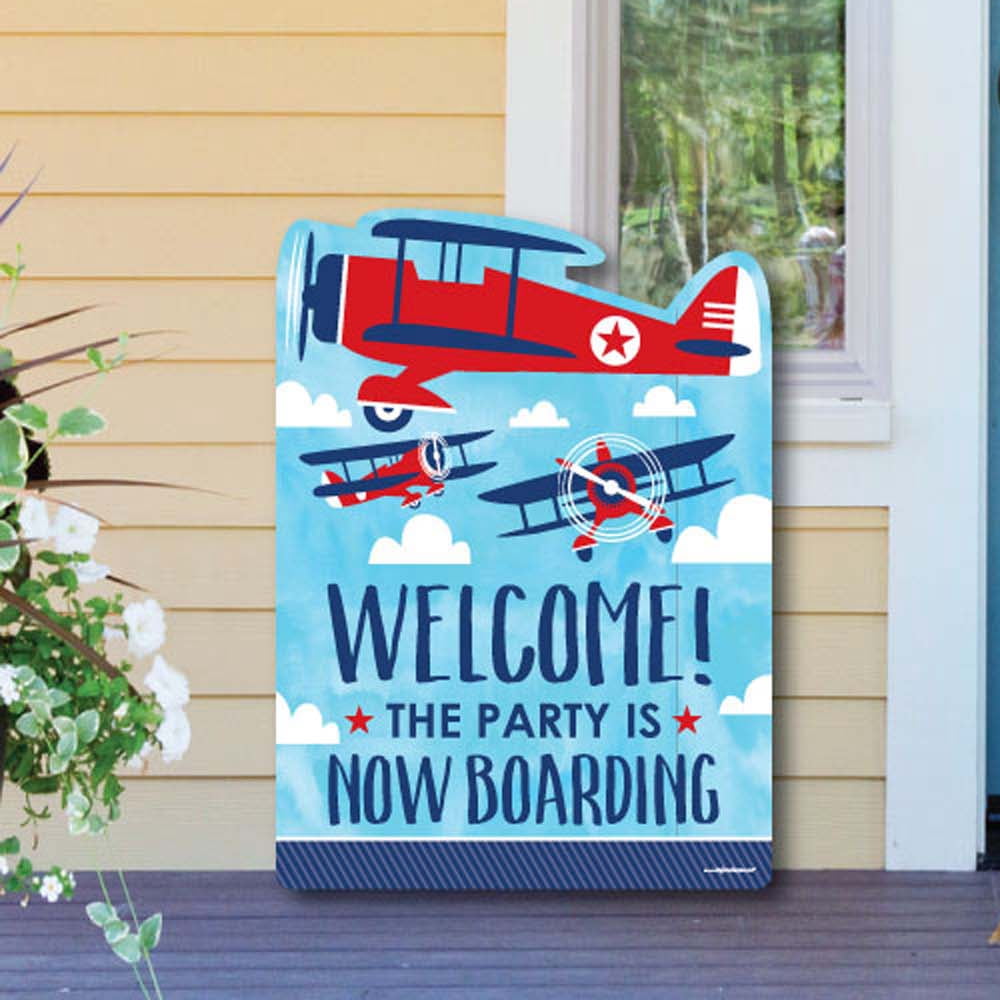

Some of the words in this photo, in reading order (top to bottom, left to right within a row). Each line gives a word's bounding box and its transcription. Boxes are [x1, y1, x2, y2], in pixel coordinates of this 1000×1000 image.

[327, 581, 712, 687] WELCOME!
[386, 703, 461, 738] THE
[478, 703, 609, 738] PARTY
[627, 703, 661, 738] IS
[328, 753, 452, 826] NOW
[466, 753, 720, 826] BOARDING
